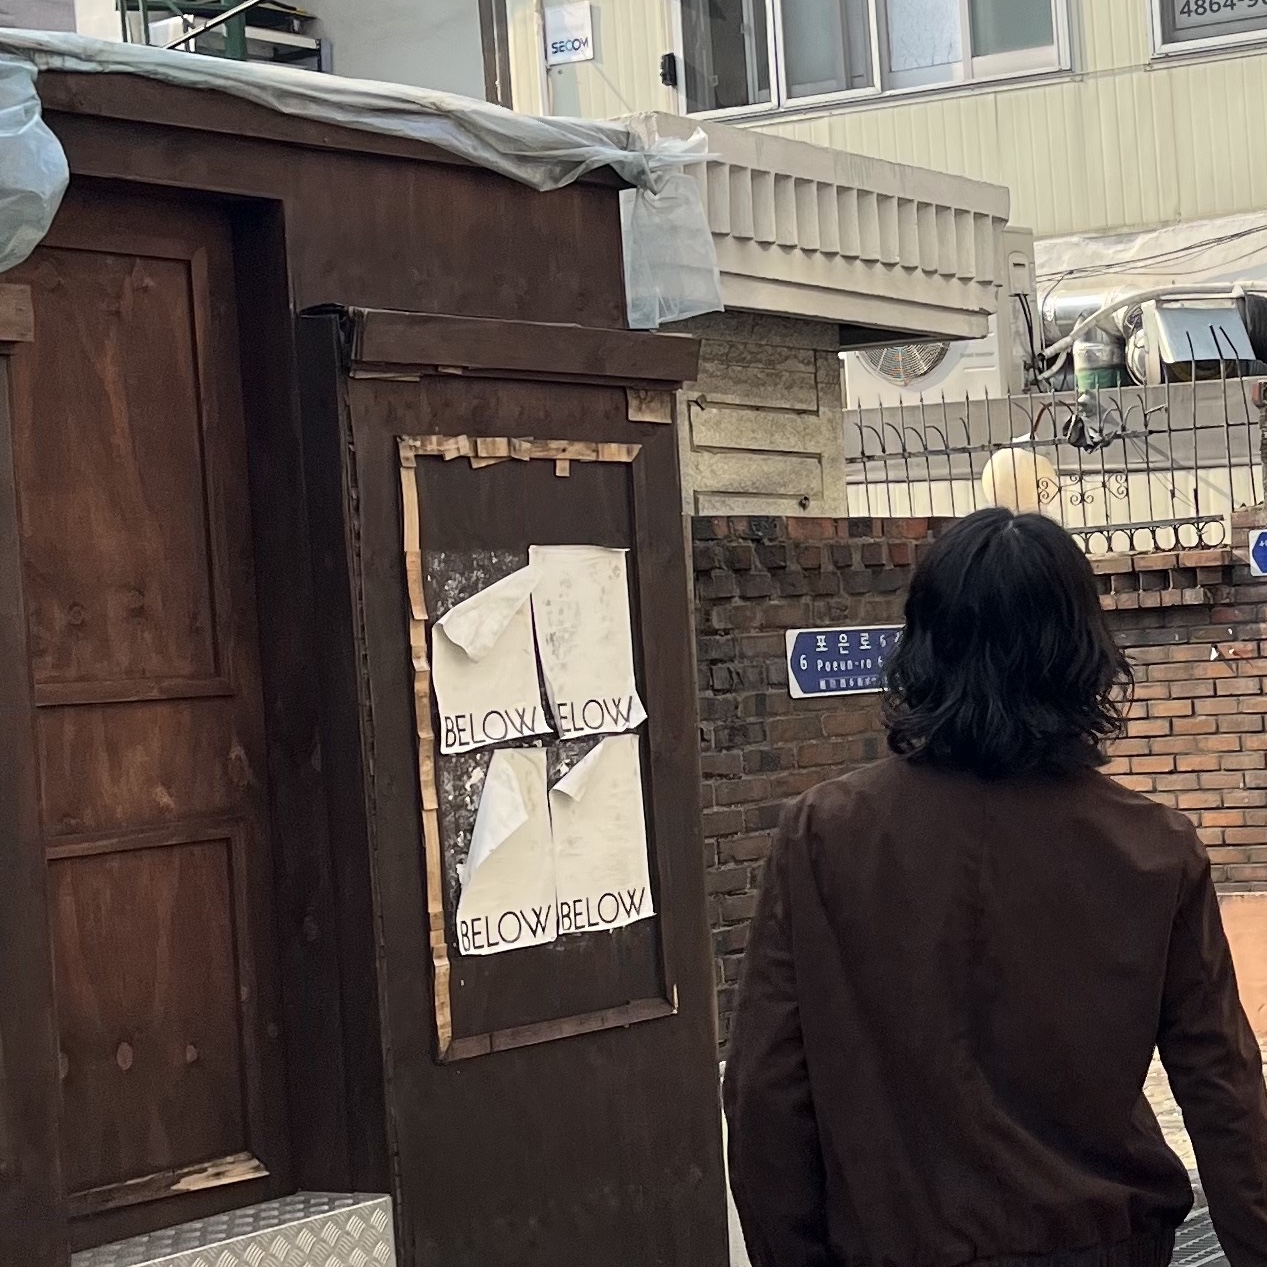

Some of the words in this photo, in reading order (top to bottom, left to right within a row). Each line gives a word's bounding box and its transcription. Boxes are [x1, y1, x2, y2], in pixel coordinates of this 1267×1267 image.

[551, 37, 588, 54] SECOM
[444, 706, 537, 748] BELOW
[557, 695, 633, 733] ELOW
[460, 904, 552, 952] BELOW
[559, 886, 646, 931] BELOW
